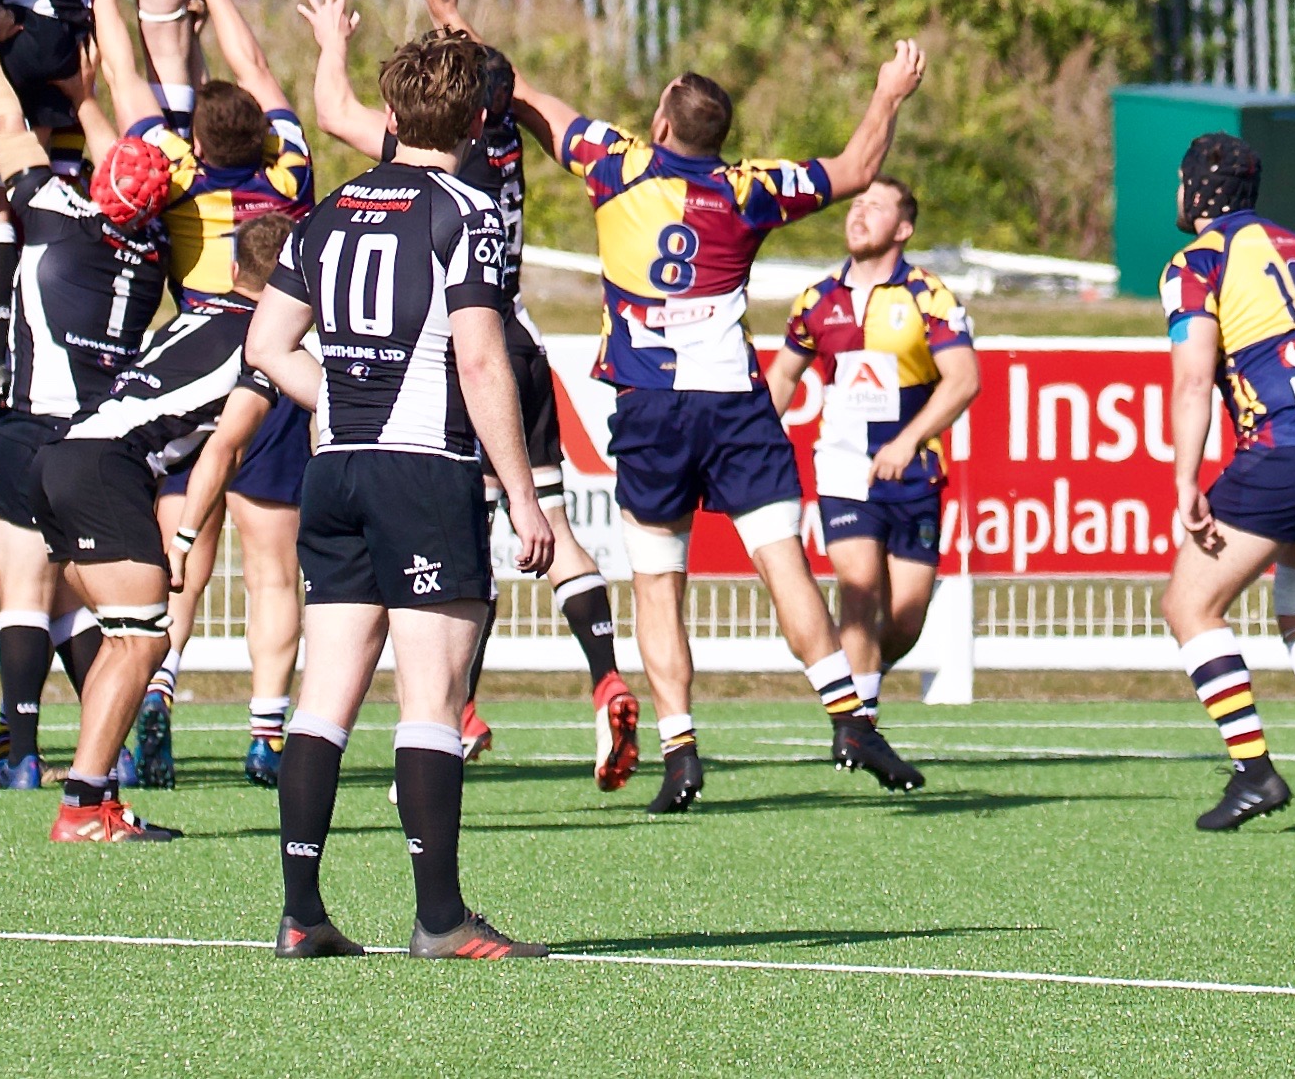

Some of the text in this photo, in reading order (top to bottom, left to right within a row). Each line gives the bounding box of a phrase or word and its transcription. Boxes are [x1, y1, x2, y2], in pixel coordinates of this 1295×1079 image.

[341, 184, 421, 201] WILDMAN
[350, 210, 389, 224] LTD
[113, 248, 142, 266] LTD
[474, 237, 505, 267] 6X
[646, 221, 700, 295] 8
[319, 229, 399, 338] 10
[106, 268, 136, 339] 1
[134, 313, 213, 370] 7
[378, 349, 407, 362] LTD
[413, 571, 442, 594] 6X
